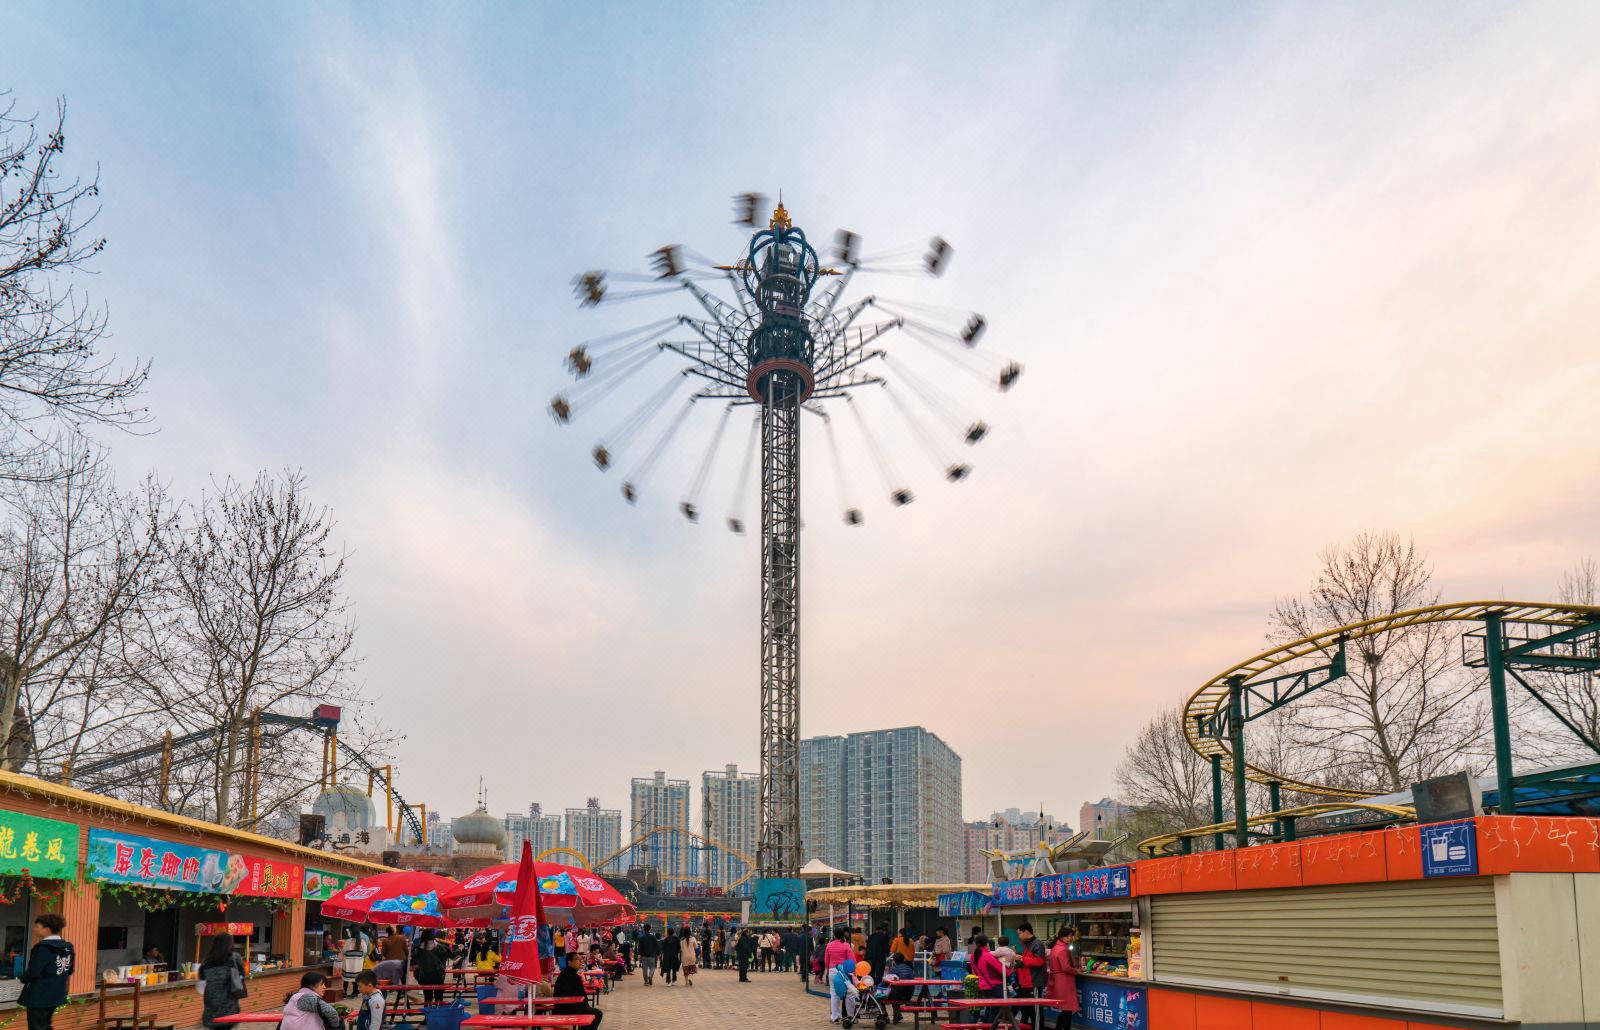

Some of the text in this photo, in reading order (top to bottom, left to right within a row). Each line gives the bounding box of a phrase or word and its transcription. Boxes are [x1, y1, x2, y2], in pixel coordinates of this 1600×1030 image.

[1091, 991, 1109, 1007] 冷饮
[1087, 1006, 1113, 1024] 小食品
